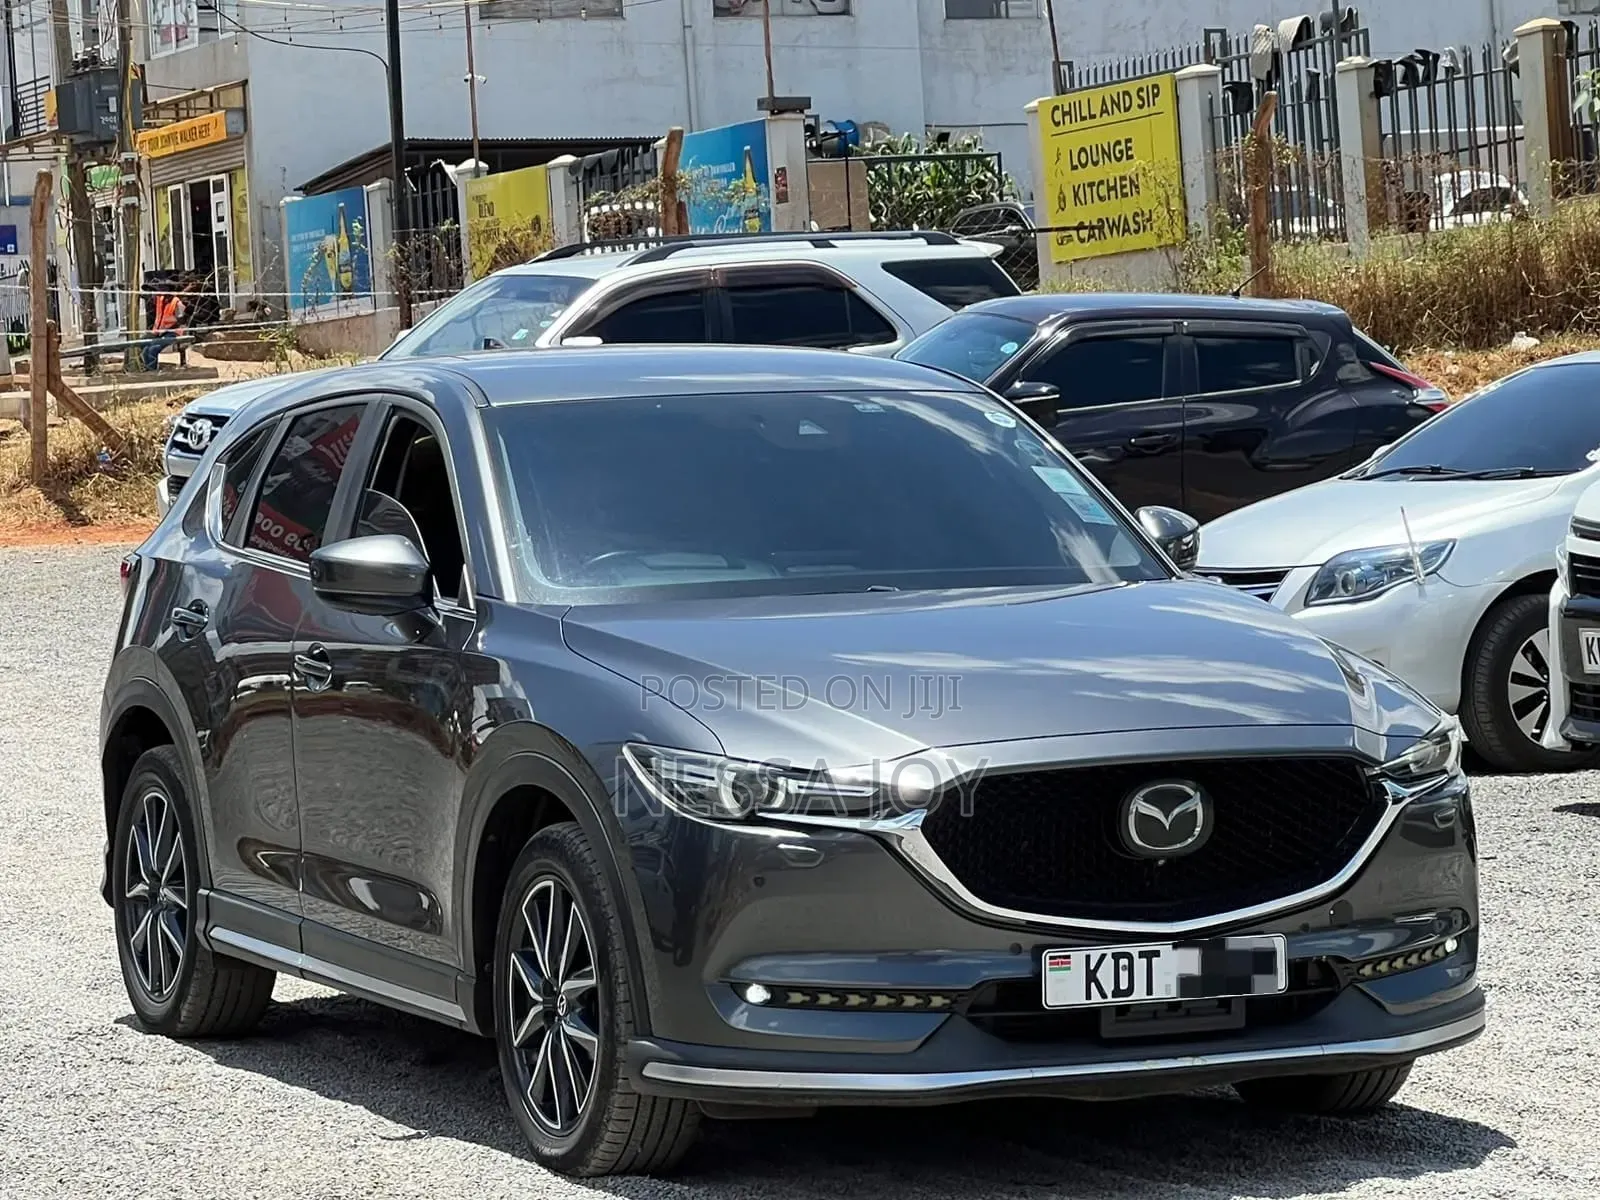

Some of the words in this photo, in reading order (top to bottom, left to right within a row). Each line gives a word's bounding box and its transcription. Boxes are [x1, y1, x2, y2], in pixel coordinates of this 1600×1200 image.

[1051, 98, 1096, 127] CHILL
[1100, 90, 1132, 119] AND
[1137, 84, 1160, 110] SIP
[180, 126, 198, 143] WALKER
[198, 122, 211, 138] HERE
[1069, 138, 1134, 171] LOUNGE
[1072, 174, 1141, 207] KITCHEN
[1076, 209, 1154, 244] CARWASH
[1085, 949, 1161, 1001] KDT
